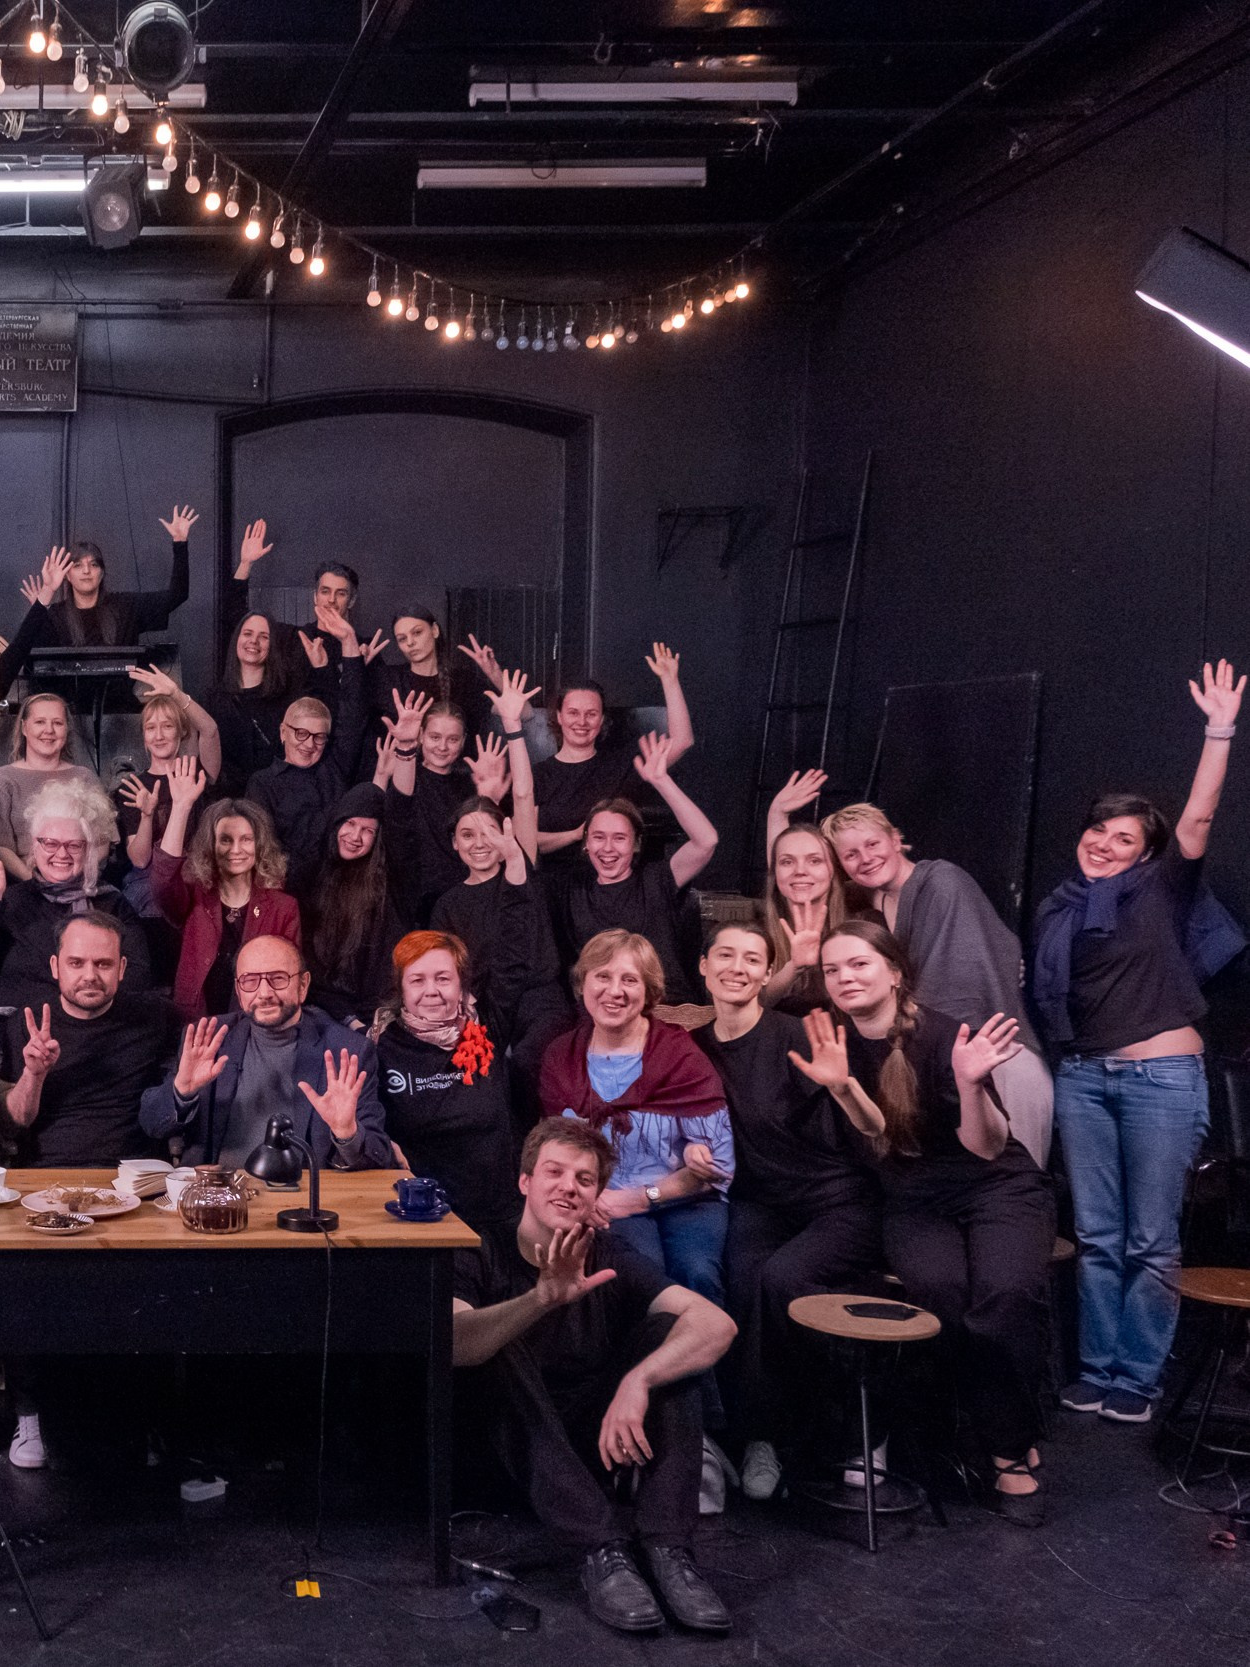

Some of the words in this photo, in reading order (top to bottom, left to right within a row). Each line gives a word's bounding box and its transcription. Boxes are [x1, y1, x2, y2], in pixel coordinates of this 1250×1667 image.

[18, 343, 72, 351] ИСКУССТВА
[26, 358, 71, 371] ТЕАТР
[23, 393, 68, 402] ACADEMY
